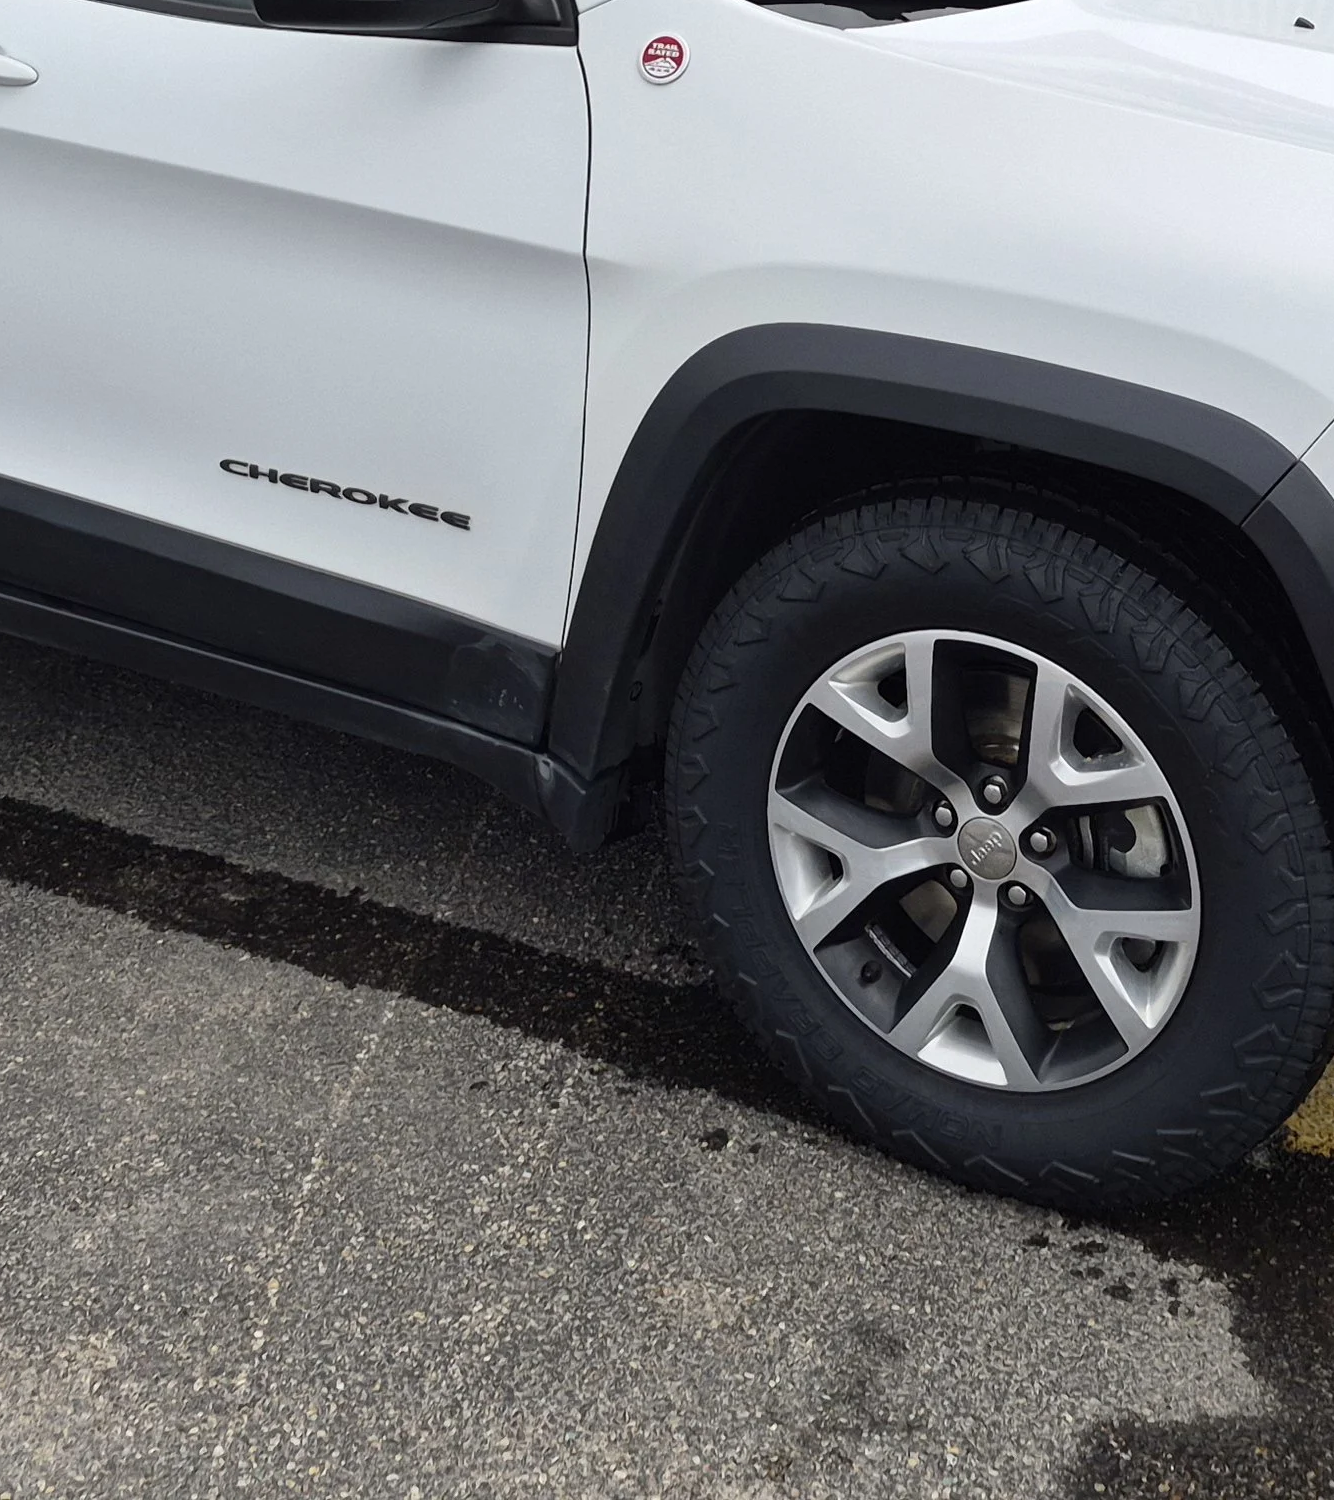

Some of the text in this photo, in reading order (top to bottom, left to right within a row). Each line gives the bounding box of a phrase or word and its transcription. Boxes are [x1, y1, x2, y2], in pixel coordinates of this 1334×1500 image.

[652, 42, 679, 51] TRAIL
[648, 48, 680, 57] RATED
[219, 458, 471, 531] CHEROKEE
